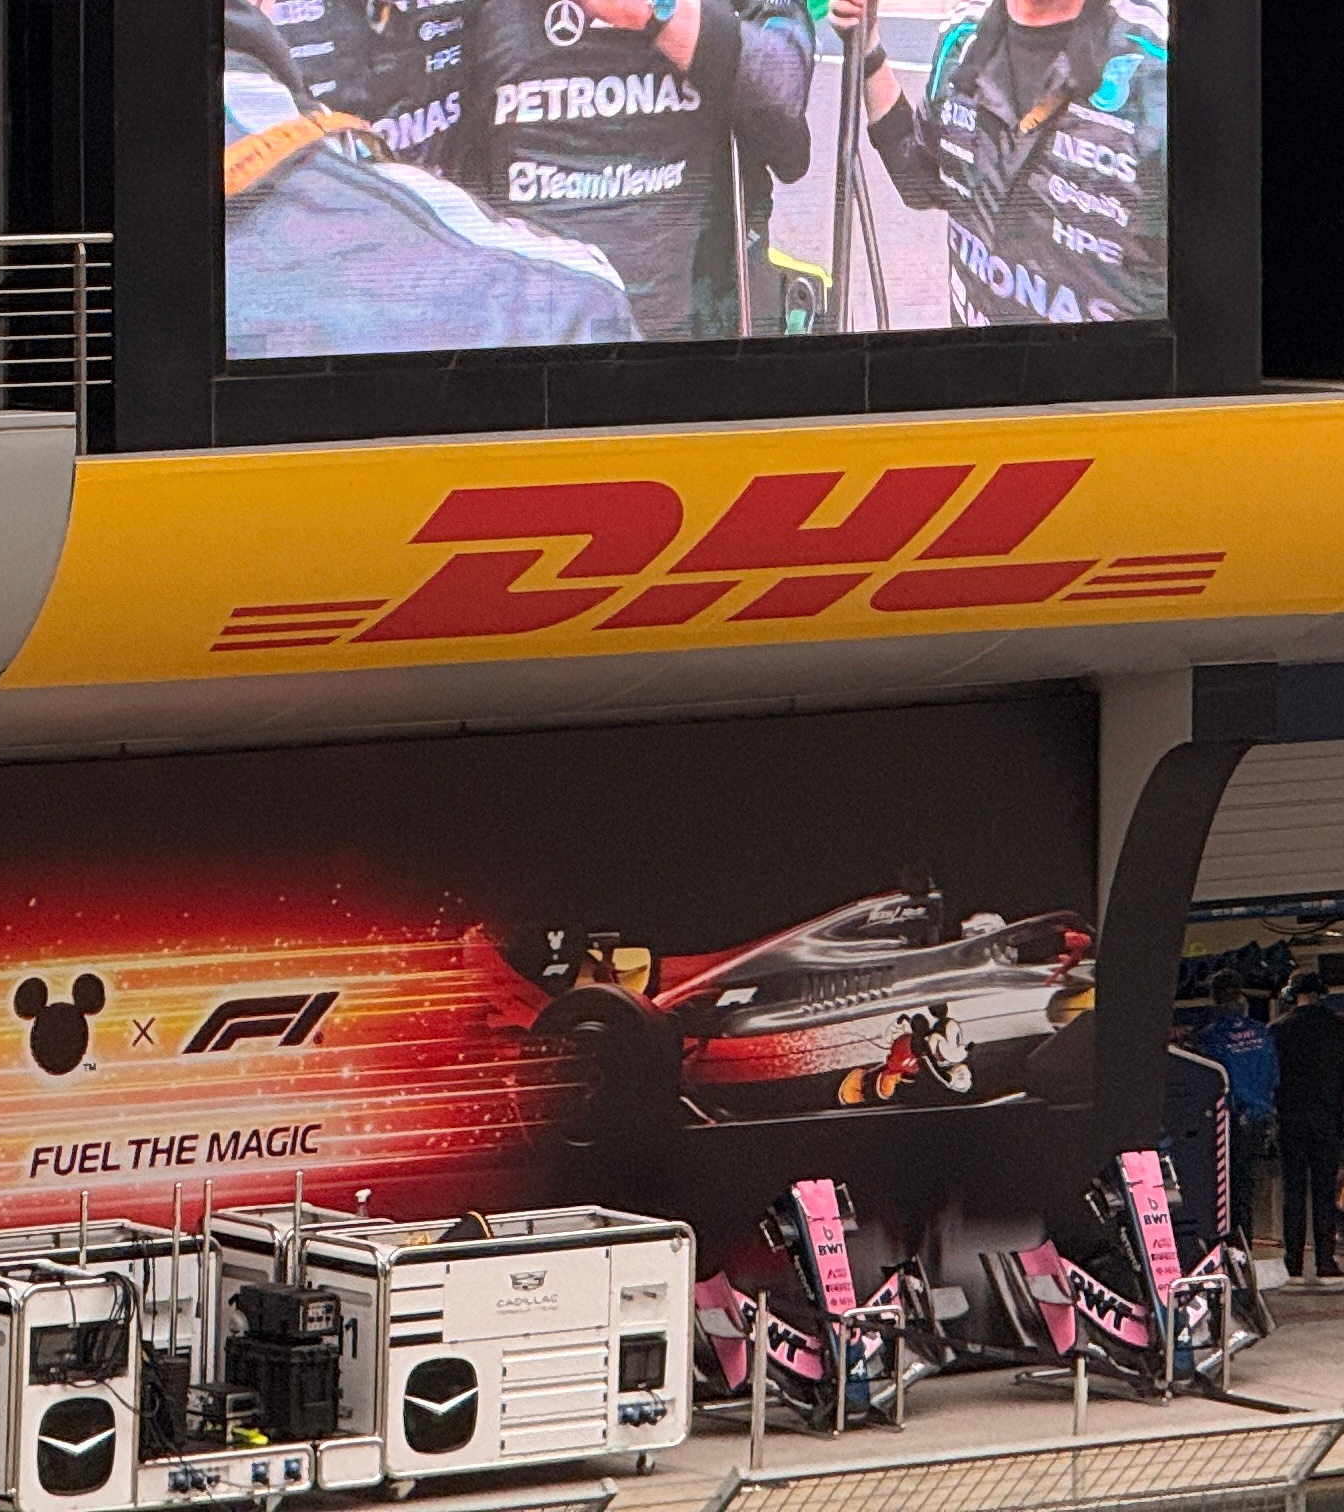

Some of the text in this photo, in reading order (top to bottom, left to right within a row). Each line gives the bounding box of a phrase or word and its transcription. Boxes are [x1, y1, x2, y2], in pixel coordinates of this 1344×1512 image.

[426, 45, 462, 73] HPE
[494, 74, 702, 126] PETRONAS
[538, 161, 687, 200] TeamViewer
[1052, 131, 1139, 184] INEOS
[1052, 217, 1124, 266] HPE
[349, 458, 1096, 643] DHL
[182, 990, 341, 1055] F1
[28, 1123, 323, 1180] FUEL THE MAGIC
[1143, 1213, 1168, 1226] BWT
[818, 1243, 844, 1257] BWT
